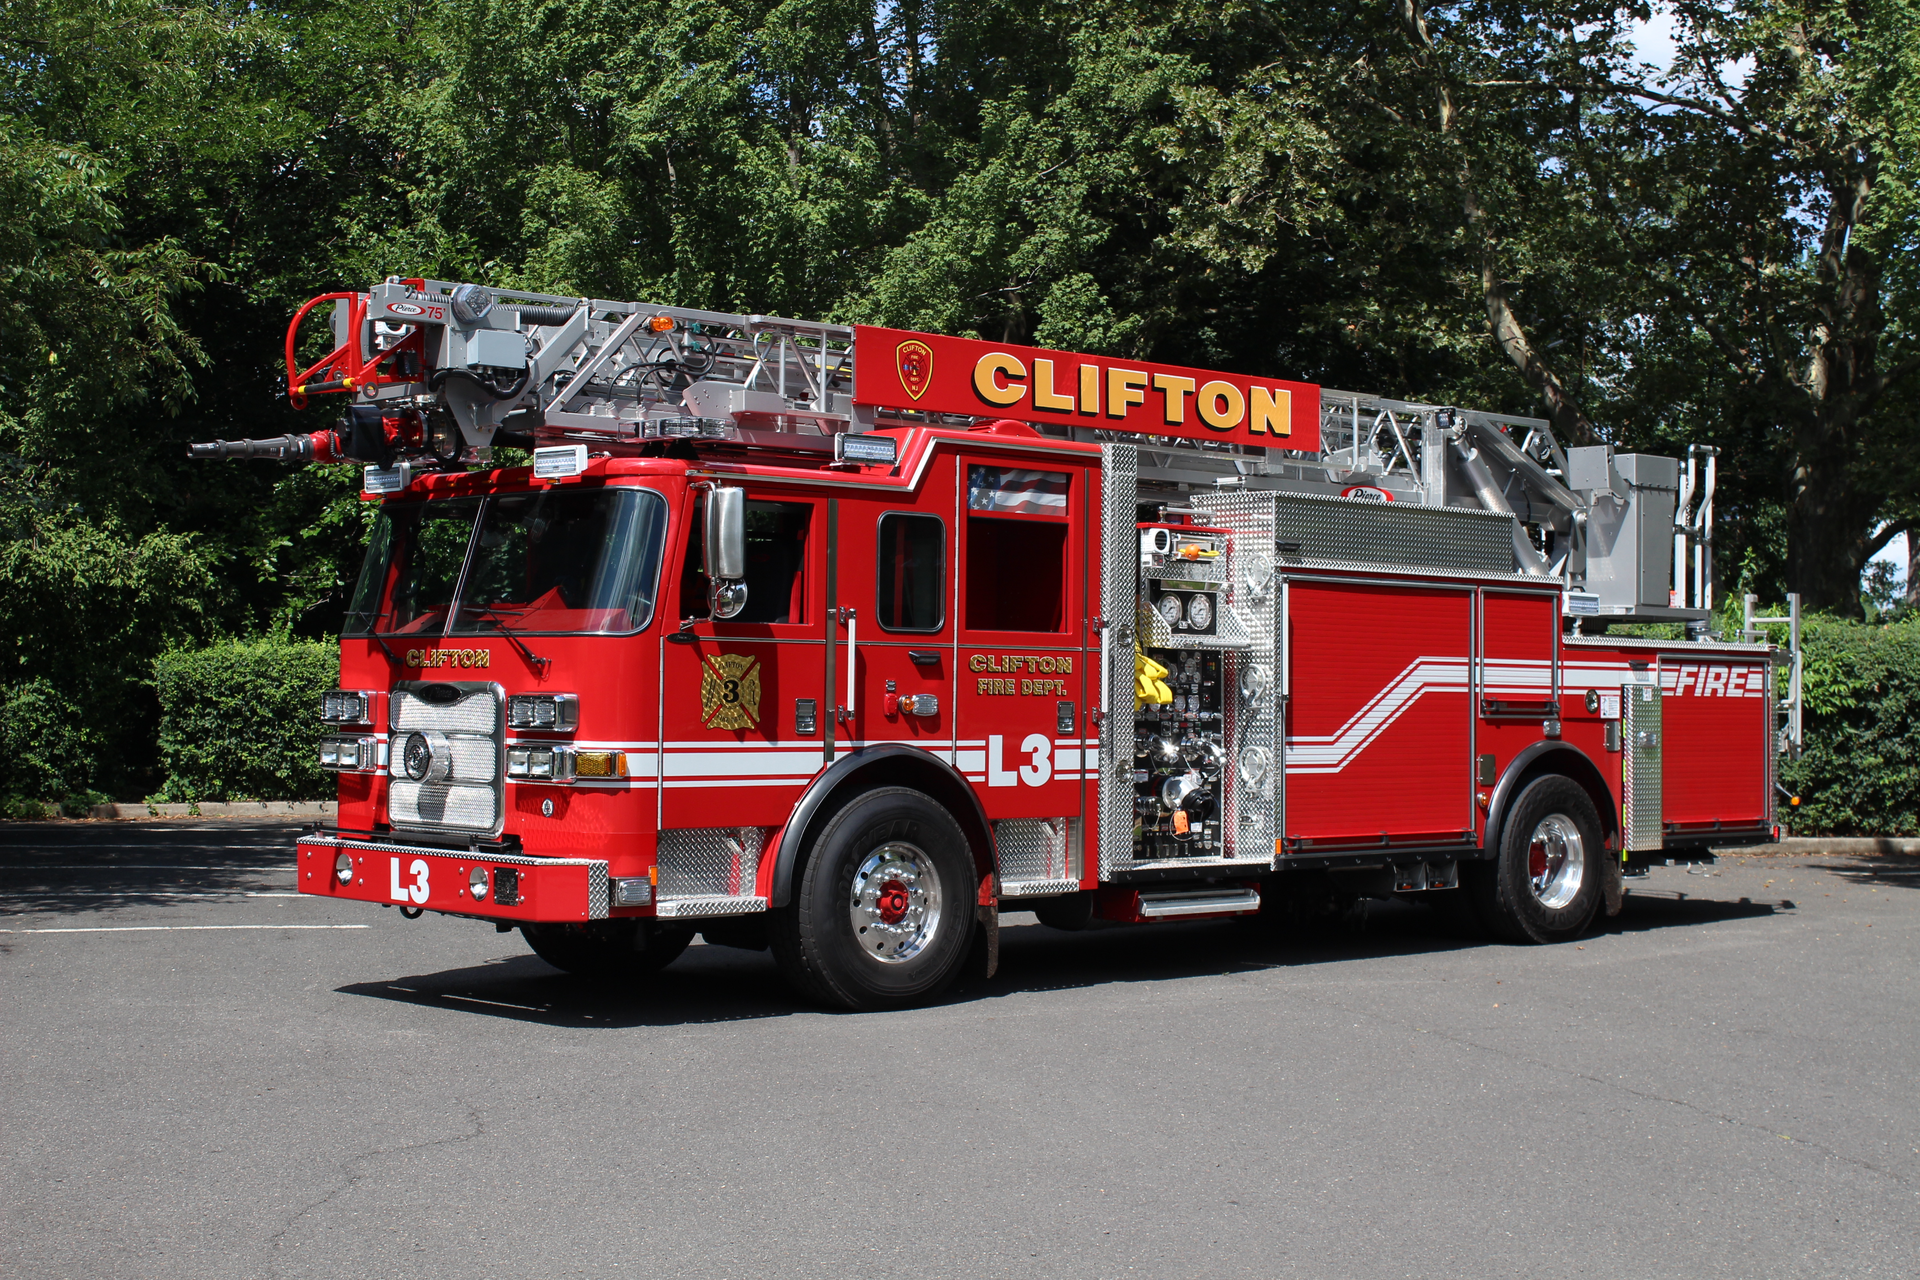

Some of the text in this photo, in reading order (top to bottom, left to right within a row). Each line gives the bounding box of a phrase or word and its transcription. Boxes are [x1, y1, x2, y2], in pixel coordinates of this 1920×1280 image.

[396, 304, 416, 313] Pierce
[902, 345, 927, 356] CLIFTON
[972, 352, 1292, 436] CLIFTON
[1353, 488, 1381, 501] Pierce
[405, 648, 490, 668] CLIFTON
[718, 661, 745, 671] CLIFTON
[969, 654, 1073, 674] CLIFTON
[977, 678, 1068, 696] FIRE DEPT.
[1675, 664, 1748, 697] FIRE
[723, 680, 739, 703] 3
[988, 733, 1052, 787] L3
[390, 856, 430, 905] L3
